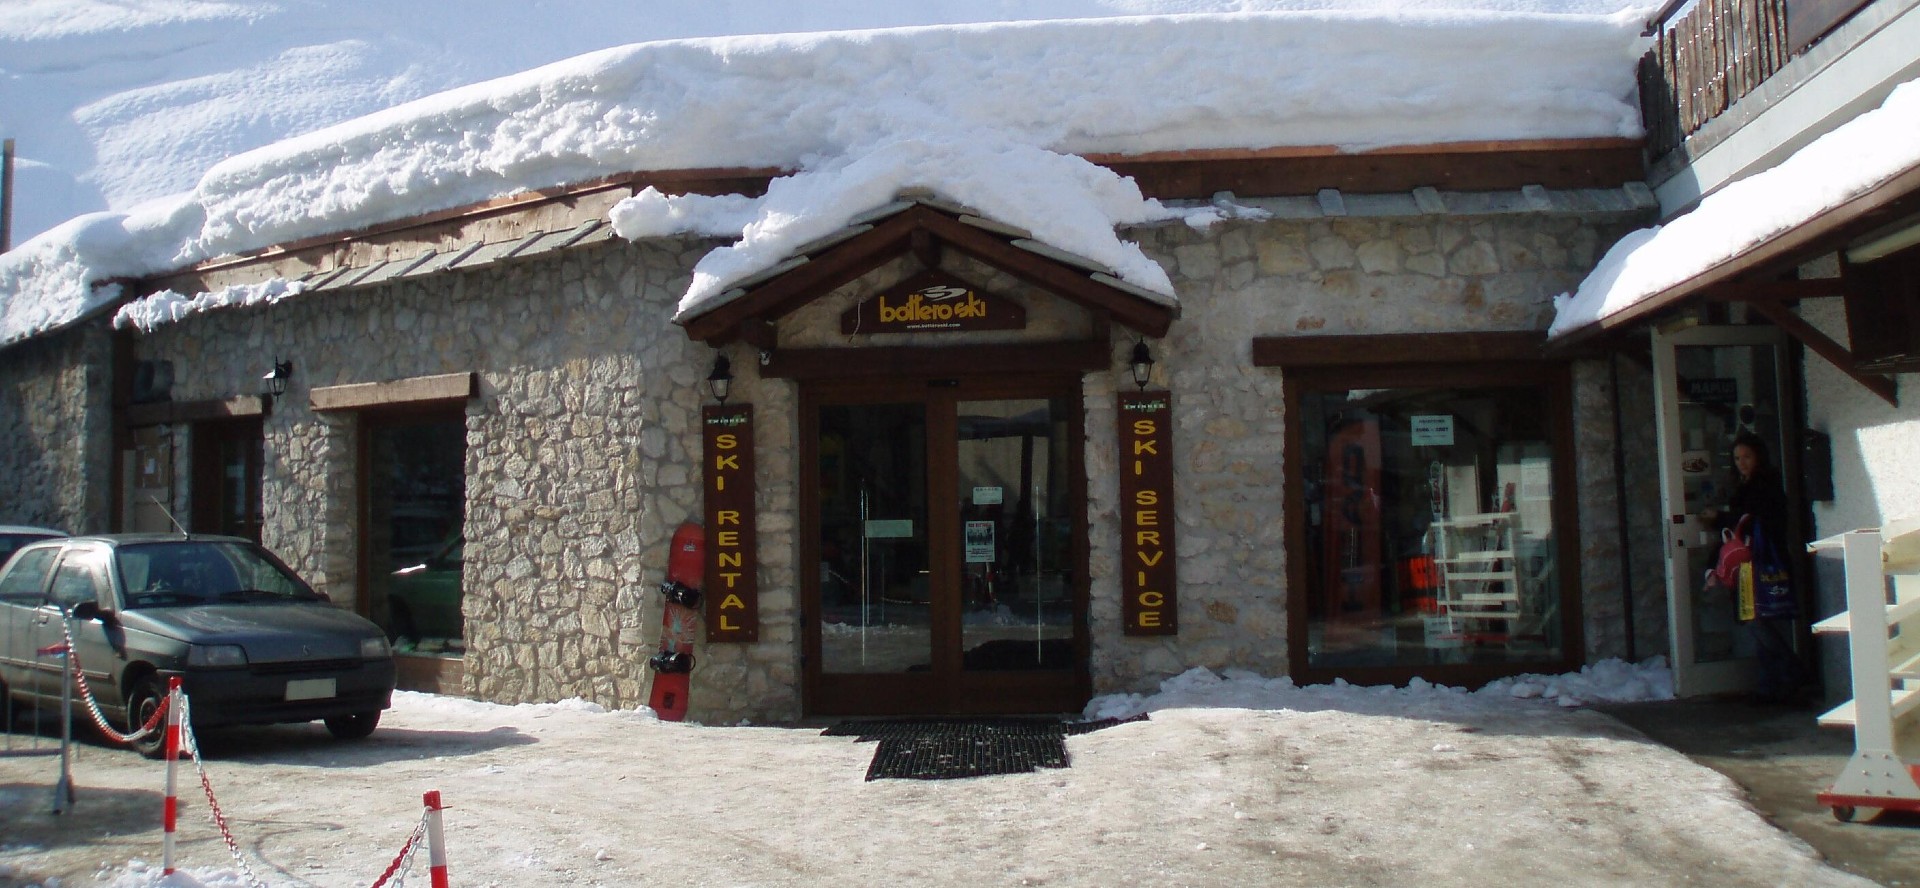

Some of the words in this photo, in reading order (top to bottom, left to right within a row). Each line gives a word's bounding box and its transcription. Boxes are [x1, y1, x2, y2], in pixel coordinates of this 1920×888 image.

[879, 293, 953, 323] bottero
[954, 290, 986, 318] ski
[716, 434, 739, 491] SKI
[1134, 420, 1157, 475] SKI
[717, 510, 745, 630] RENTAL
[1136, 490, 1163, 627] SERVICE
